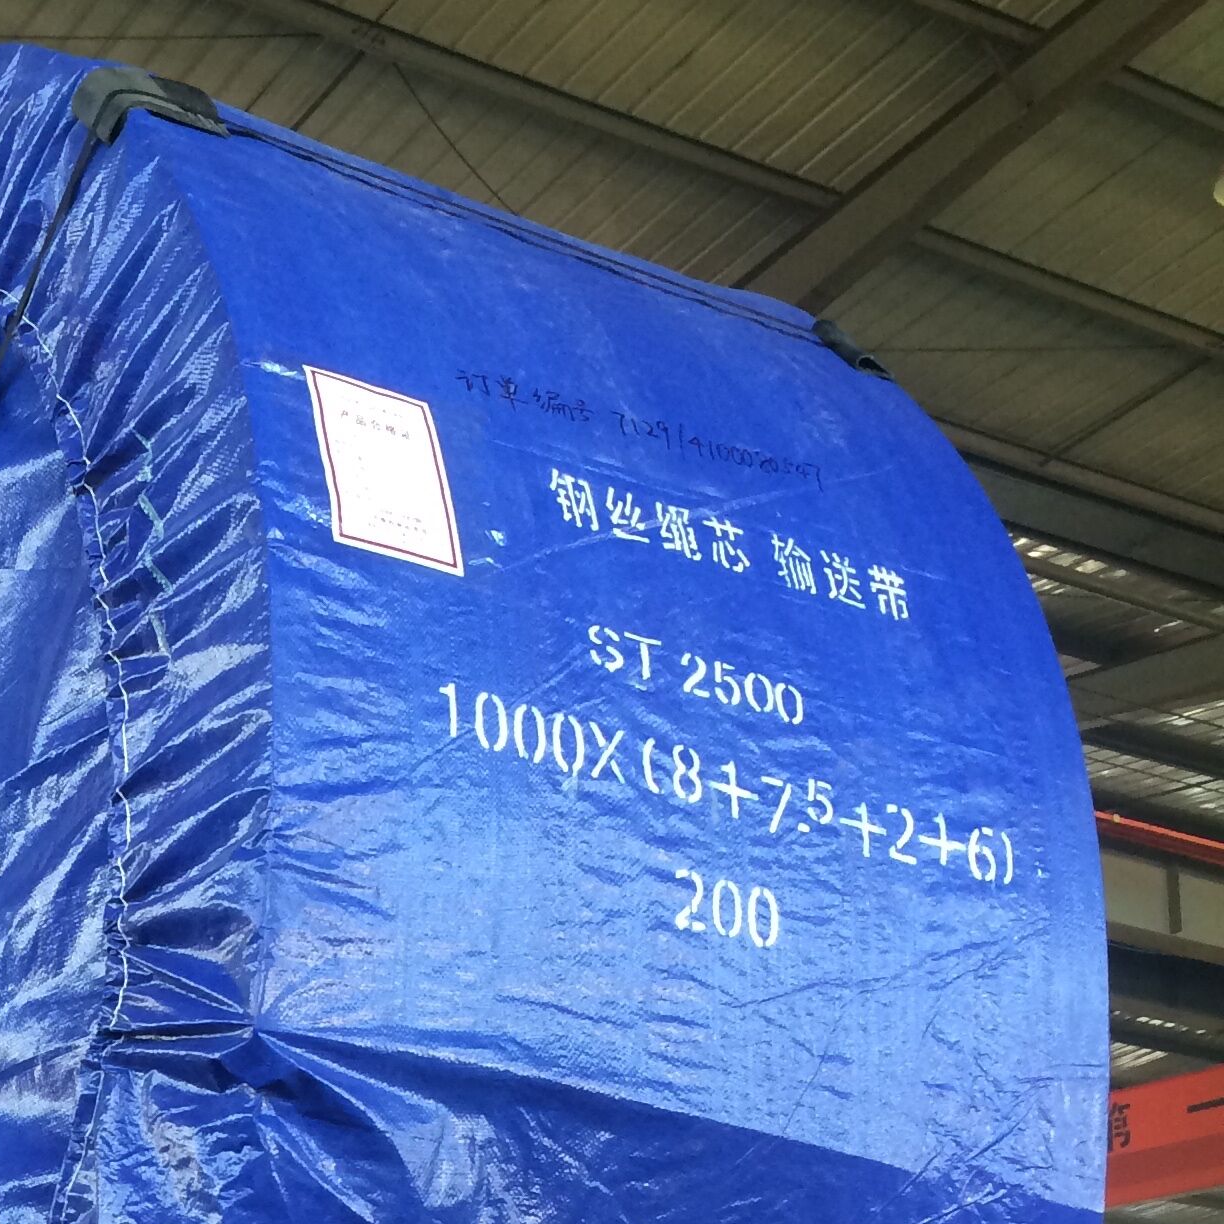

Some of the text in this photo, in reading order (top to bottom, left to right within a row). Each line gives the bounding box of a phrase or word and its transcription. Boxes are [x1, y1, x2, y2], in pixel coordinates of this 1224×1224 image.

[549, 468, 910, 621] 钢丝绳芯 输送带
[588, 624, 804, 725] ST 2500
[674, 868, 779, 948] 200
